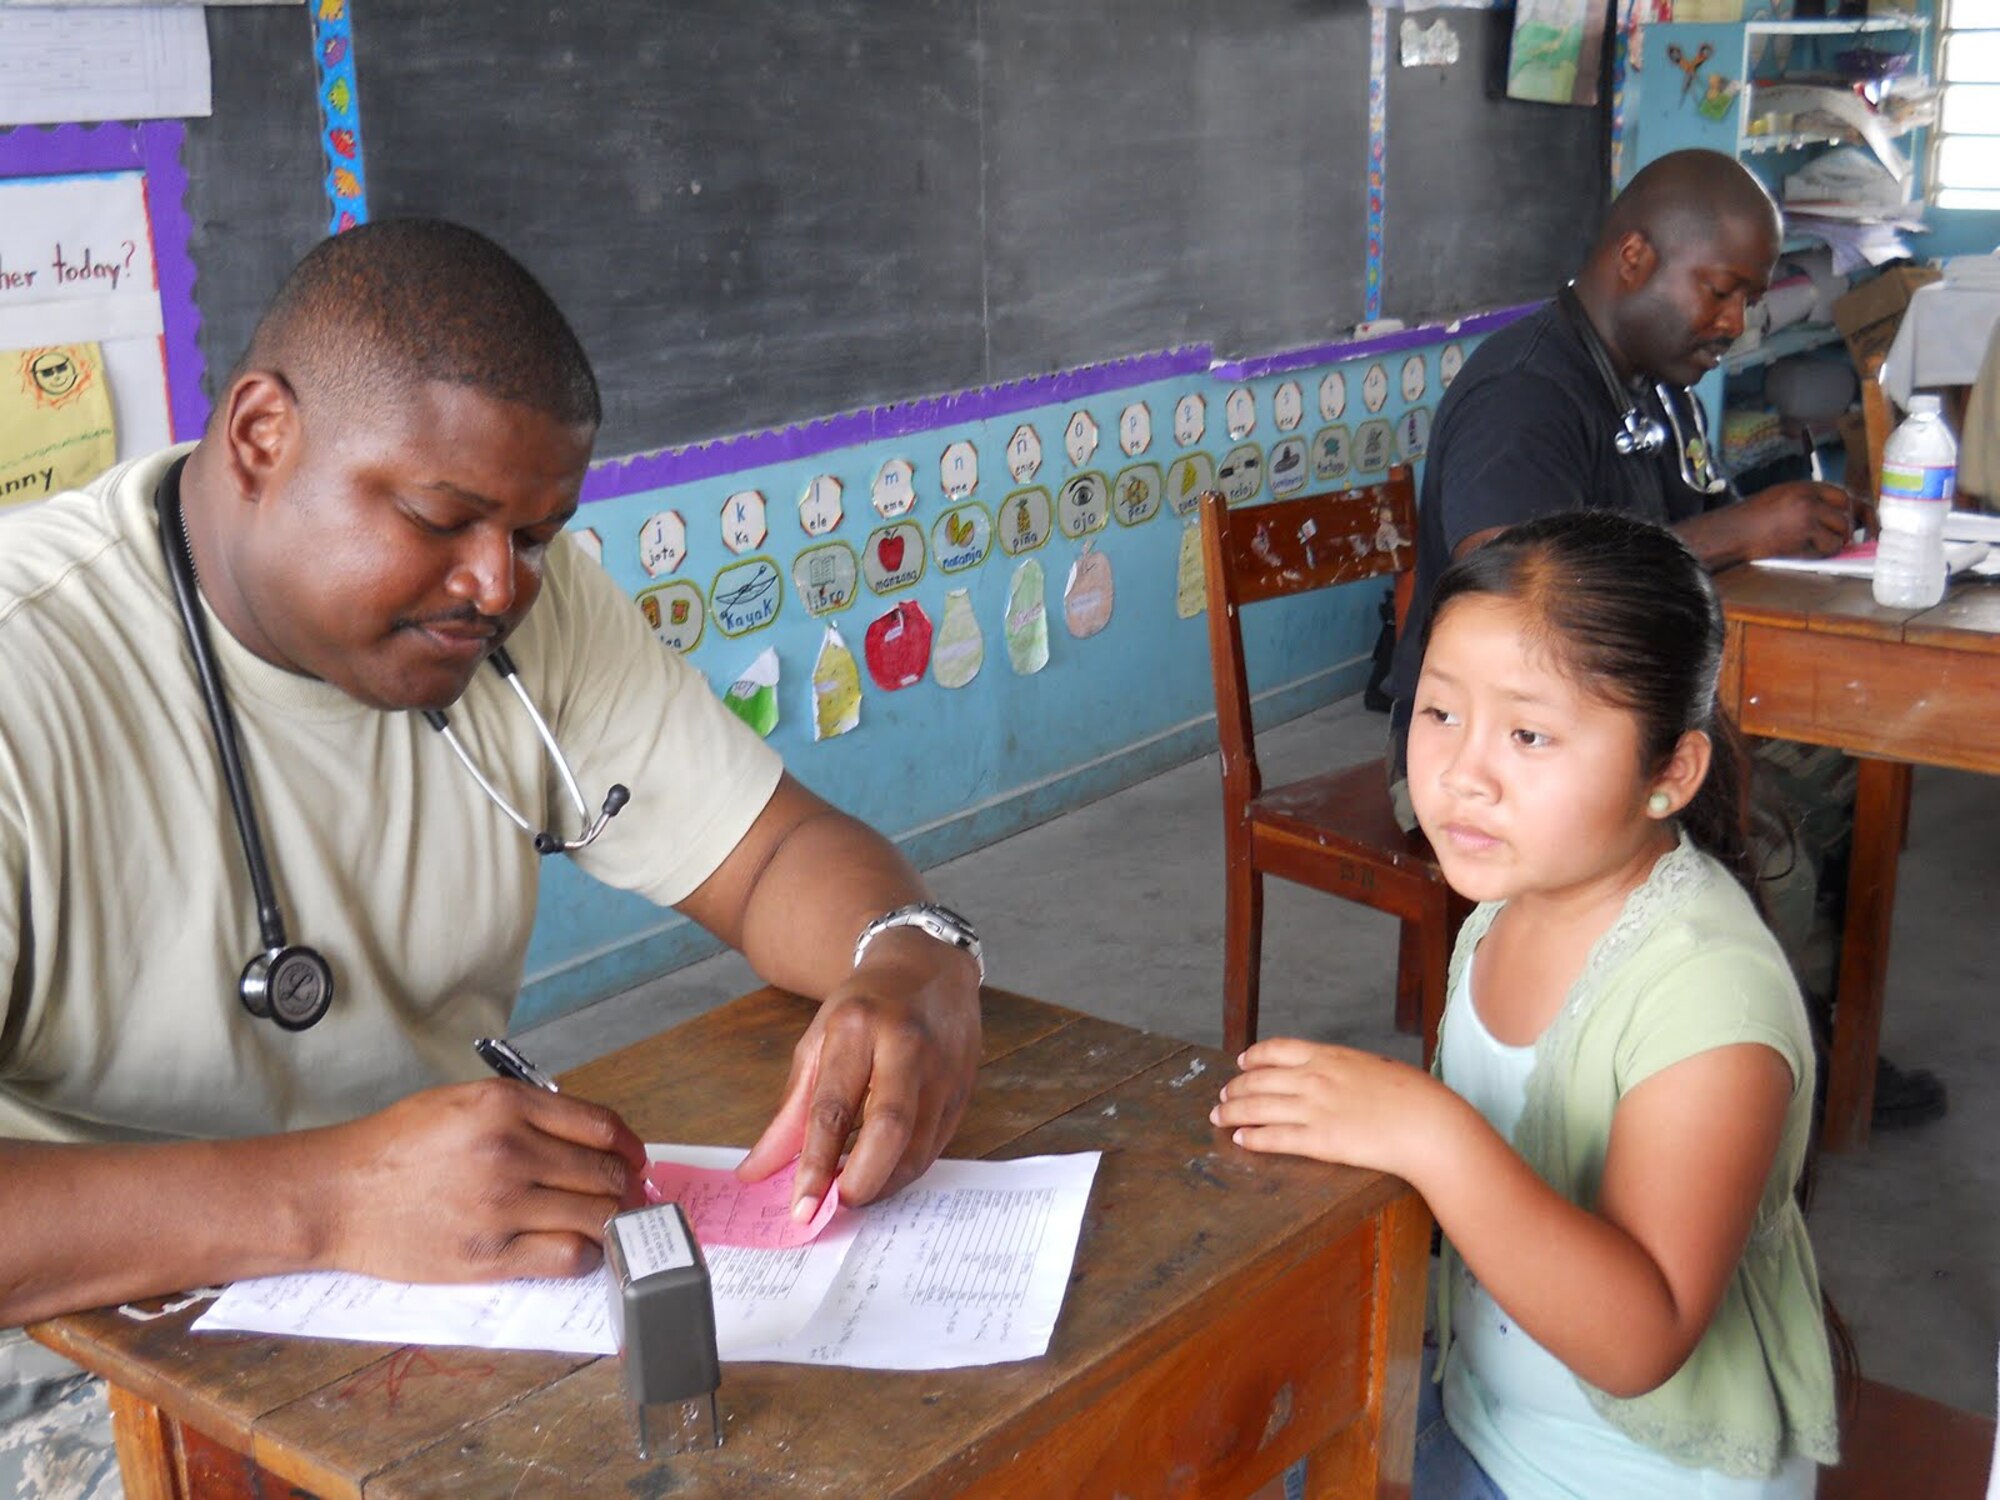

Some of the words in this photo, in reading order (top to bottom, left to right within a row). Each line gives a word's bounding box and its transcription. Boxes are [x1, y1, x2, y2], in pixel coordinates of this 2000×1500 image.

[52, 240, 135, 290] today?
[884, 472, 900, 486] m
[809, 513, 828, 530] ele
[1073, 512, 1096, 533] ojo
[648, 547, 675, 567] jota
[875, 570, 918, 591] manzana
